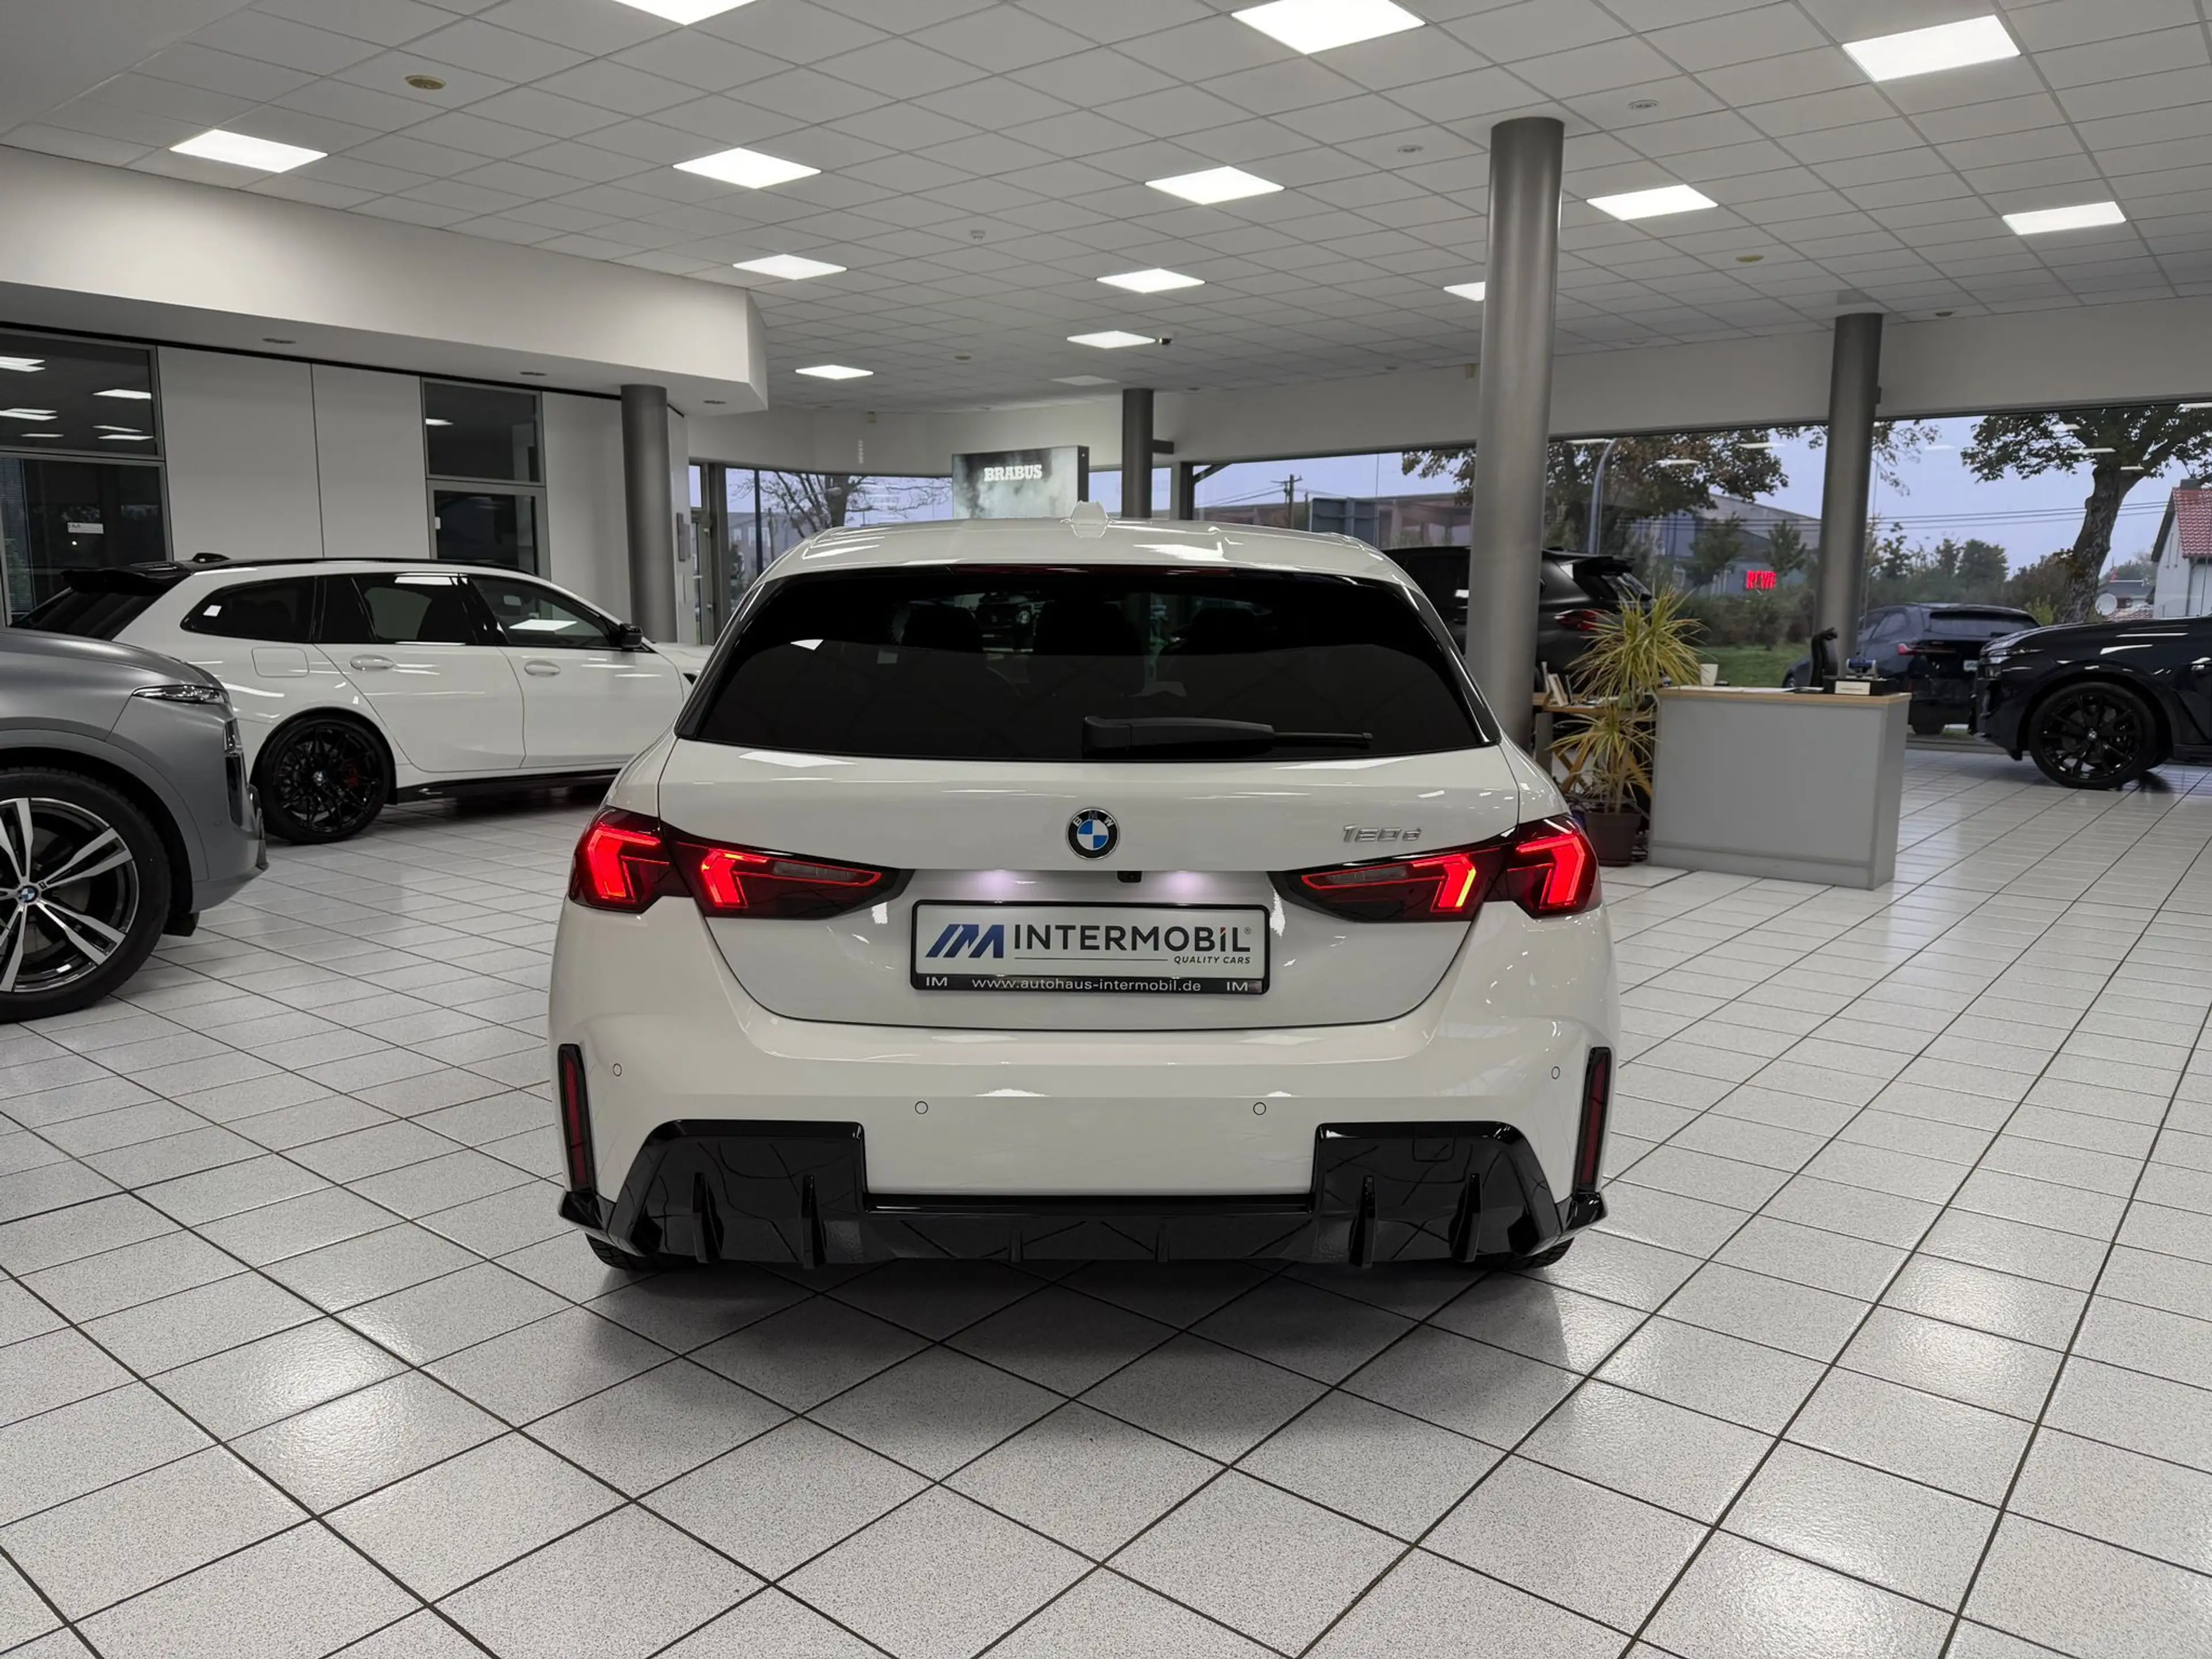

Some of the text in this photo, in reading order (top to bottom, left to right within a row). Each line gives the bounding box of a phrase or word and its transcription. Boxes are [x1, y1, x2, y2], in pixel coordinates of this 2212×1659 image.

[983, 464, 1043, 482] BRABUS
[1173, 956, 1251, 965] QUALITY CARS
[925, 976, 1249, 992] IM www.autohaus-intermobil.de IM
